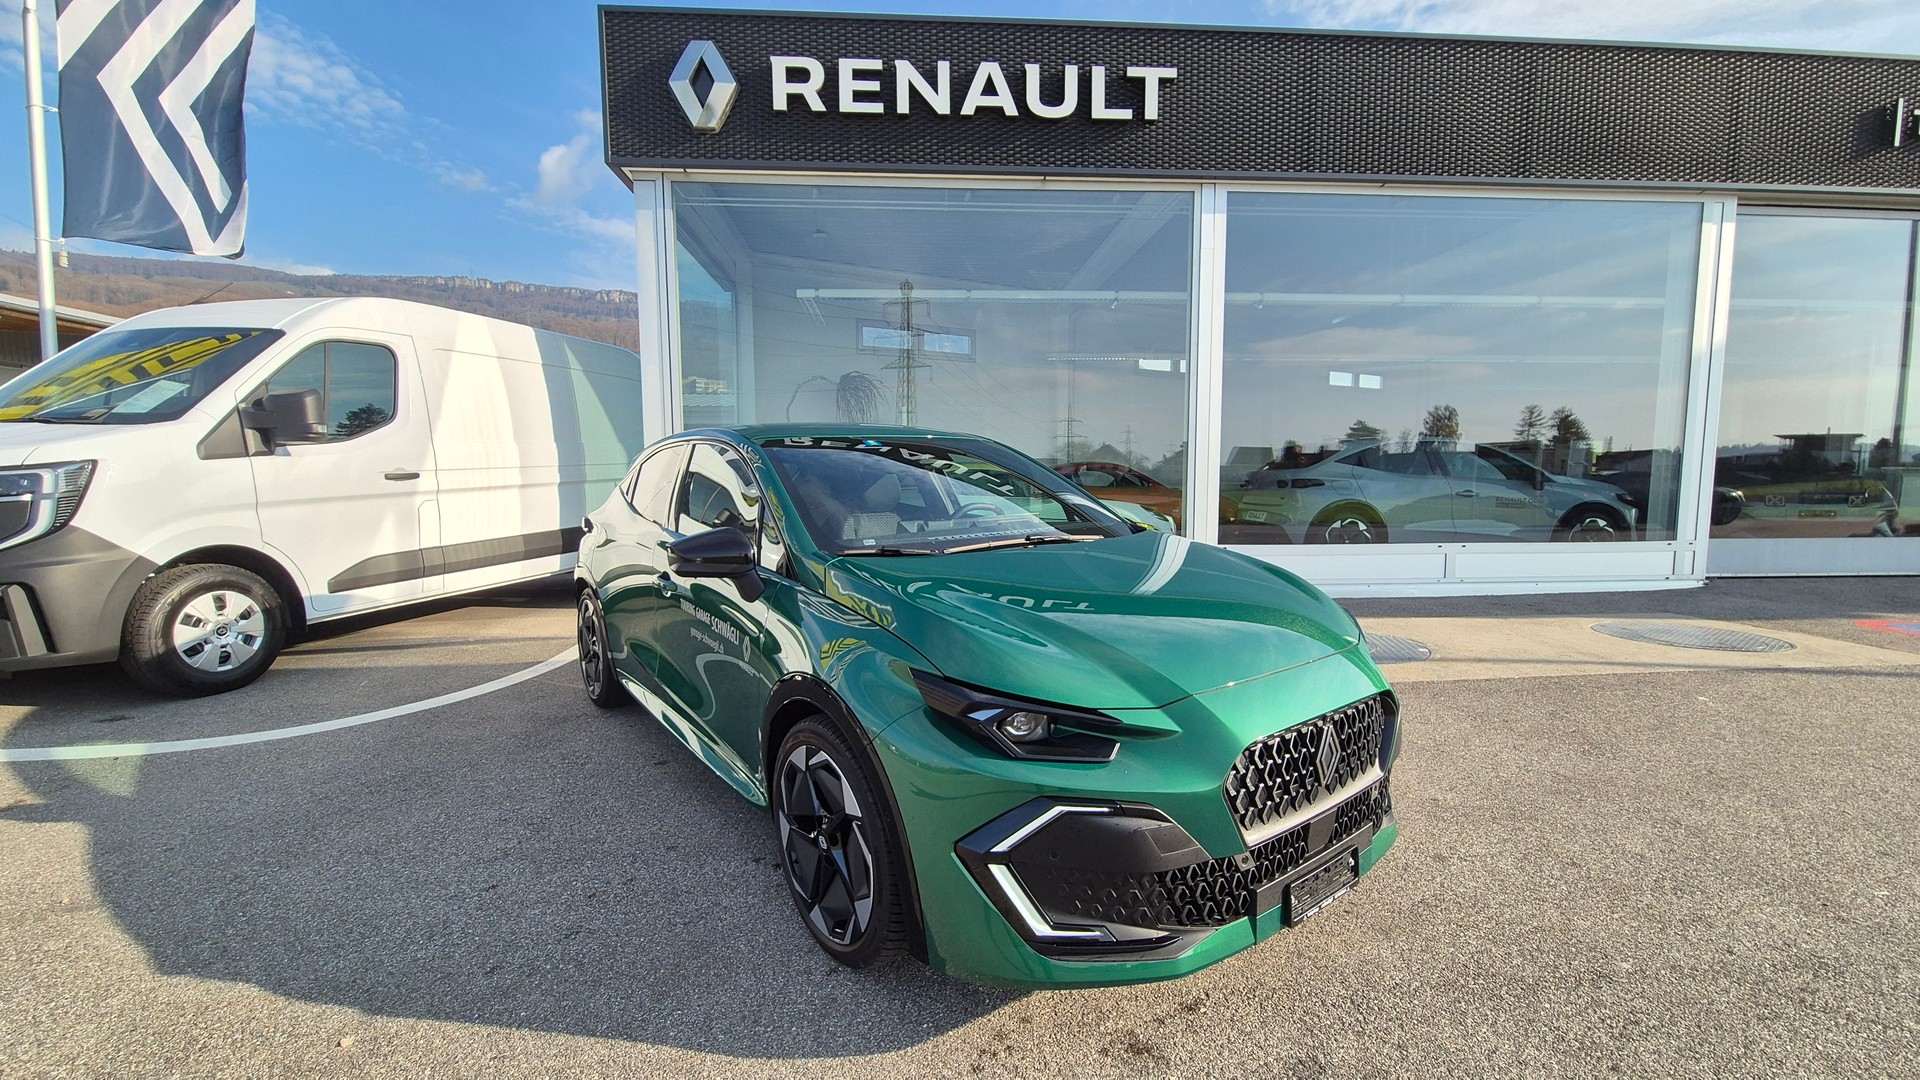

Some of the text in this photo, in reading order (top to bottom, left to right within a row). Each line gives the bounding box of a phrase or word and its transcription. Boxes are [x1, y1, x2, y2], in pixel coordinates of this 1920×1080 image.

[769, 55, 1178, 121] RENAULT
[695, 607, 711, 625] GARAGE
[711, 615, 739, 646] SCHWÄGLI
